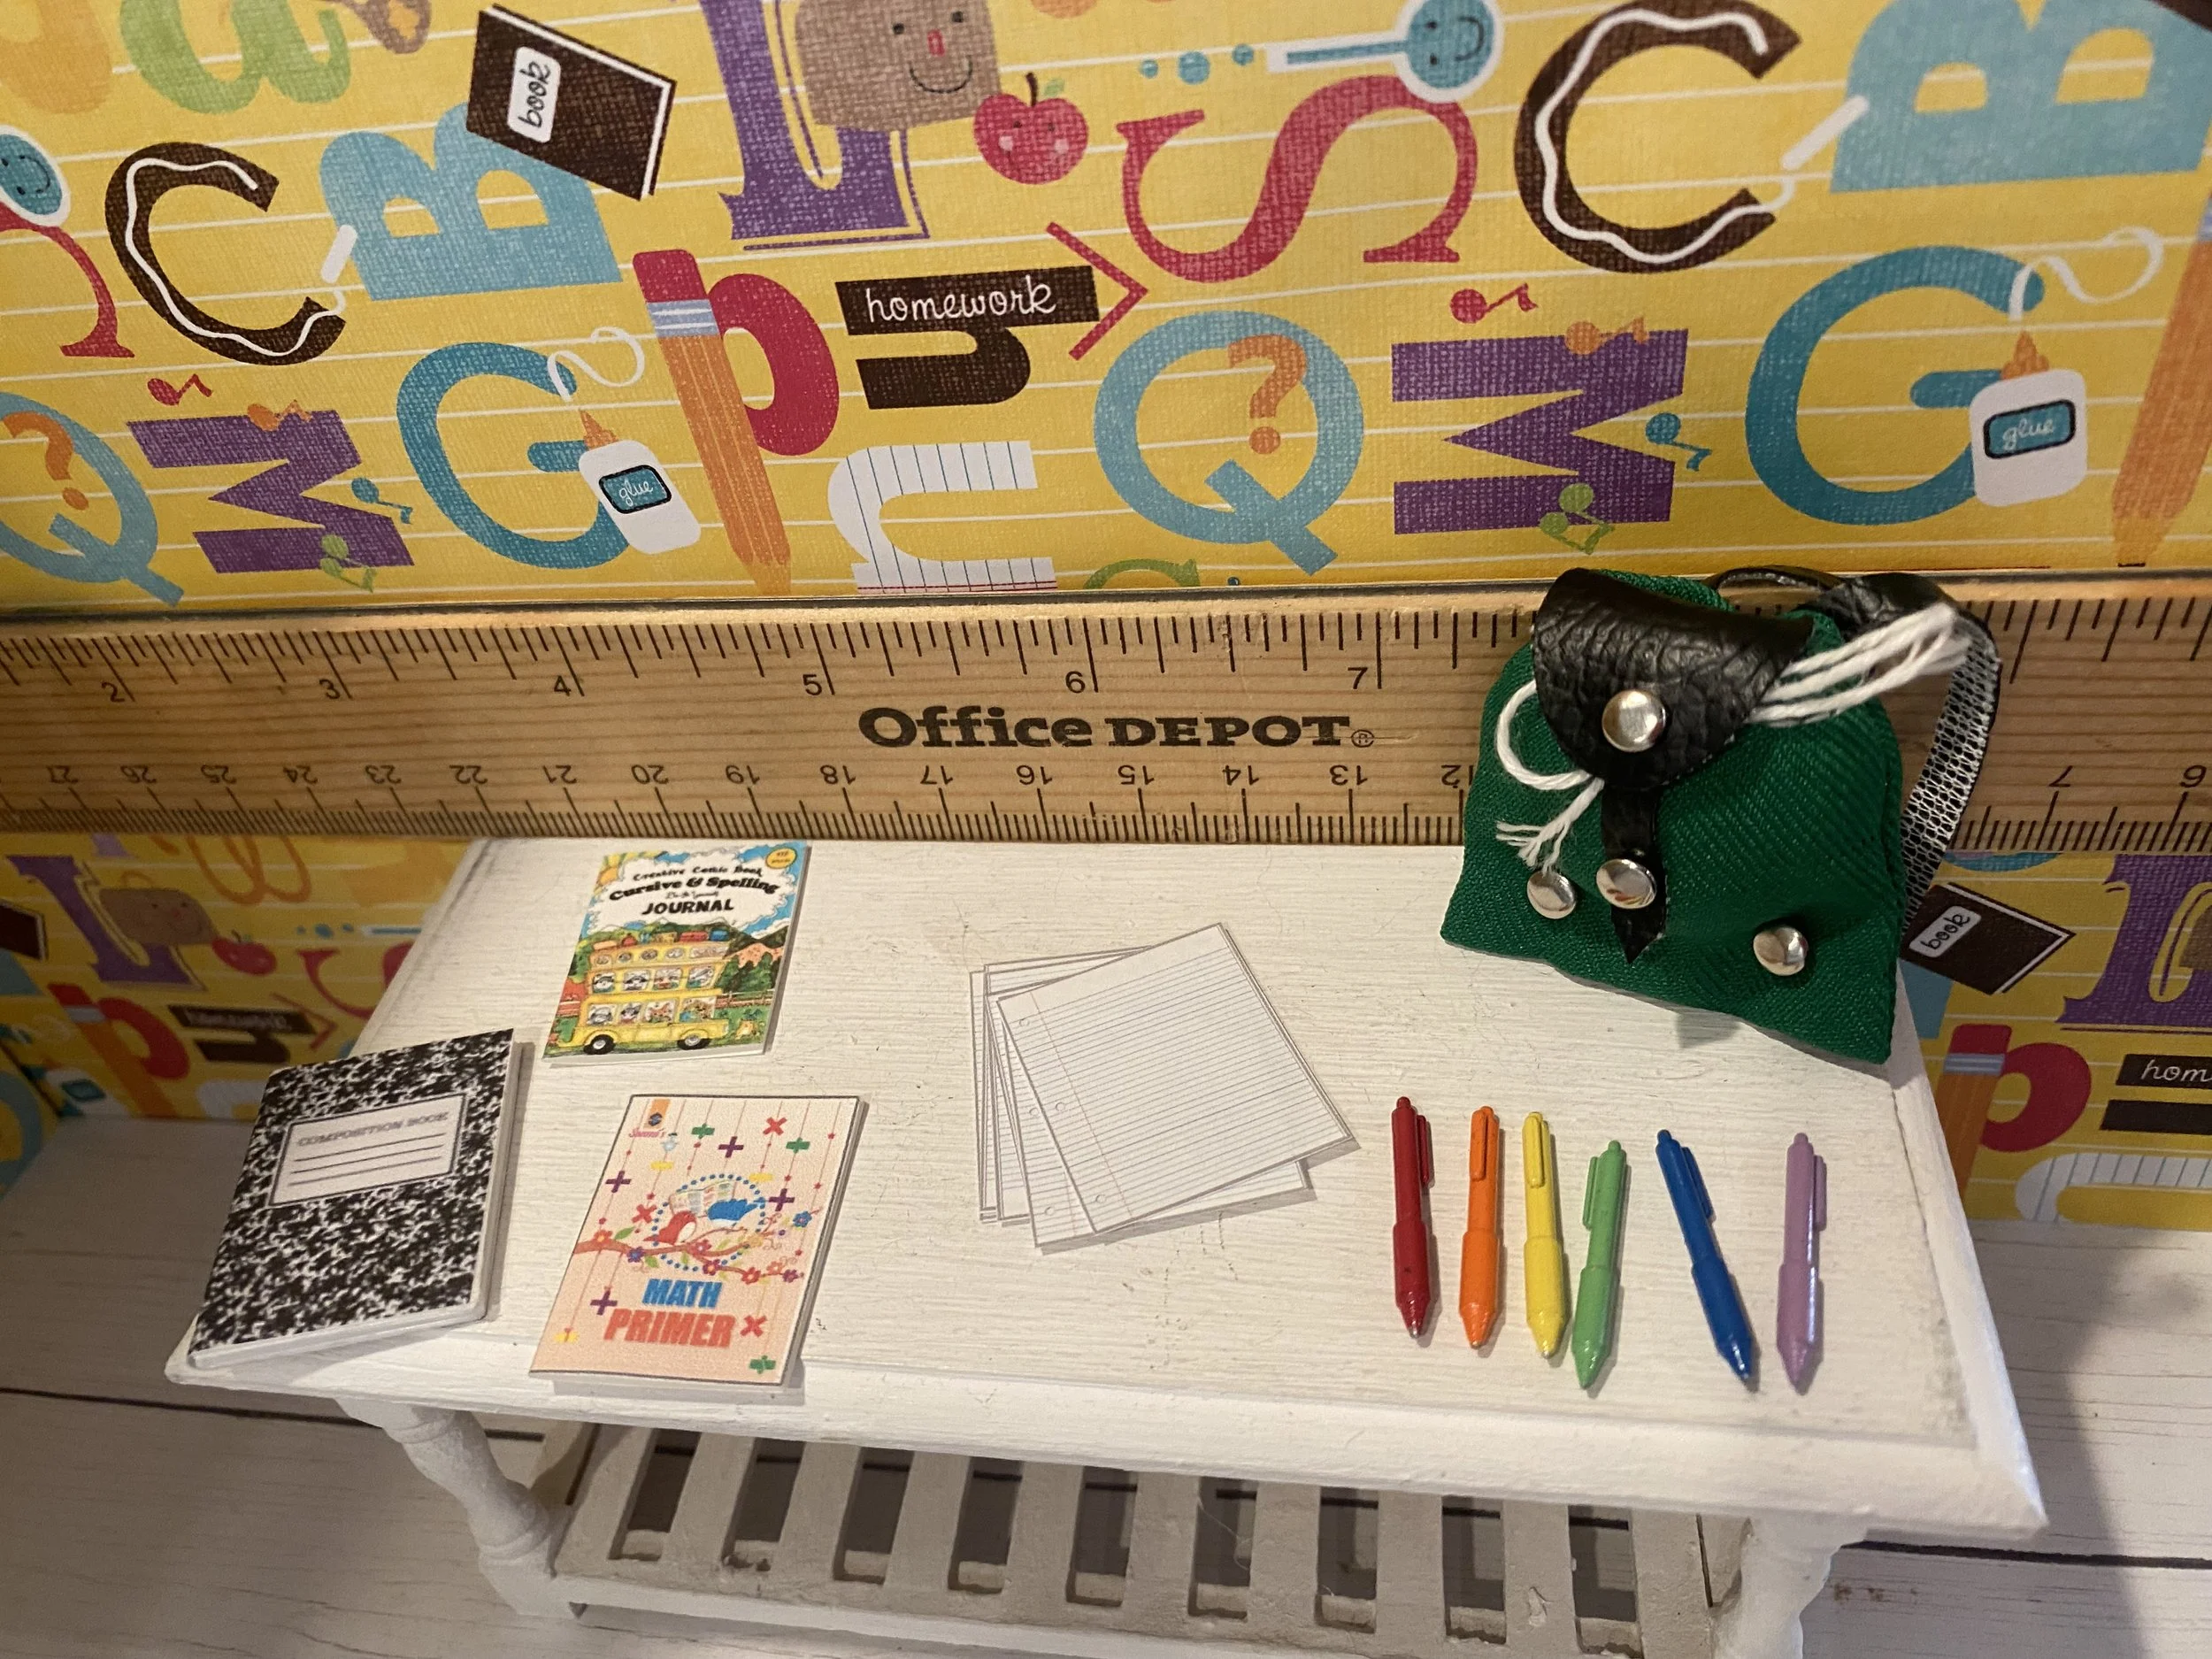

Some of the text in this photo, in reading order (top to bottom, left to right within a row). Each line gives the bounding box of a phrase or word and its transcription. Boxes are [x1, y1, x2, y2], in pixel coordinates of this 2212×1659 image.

[517, 60, 552, 128] book
[865, 273, 1057, 324] homework
[2001, 416, 2056, 452] glue
[618, 477, 654, 507] glue
[319, 679, 342, 701] 3
[553, 675, 572, 697] 4
[802, 673, 824, 696] 5
[1064, 671, 1087, 694] 6
[1347, 666, 1369, 690] 7
[101, 681, 126, 703] 2
[857, 705, 1093, 749] Office
[609, 879, 682, 901] Cursive
[706, 877, 780, 894] Spelling
[641, 897, 734, 915] JOURNAL
[1920, 912, 1970, 951] book
[406, 1111, 449, 1126] BOOK
[642, 1278, 723, 1308] MATH
[603, 1308, 736, 1348] PRIMER
